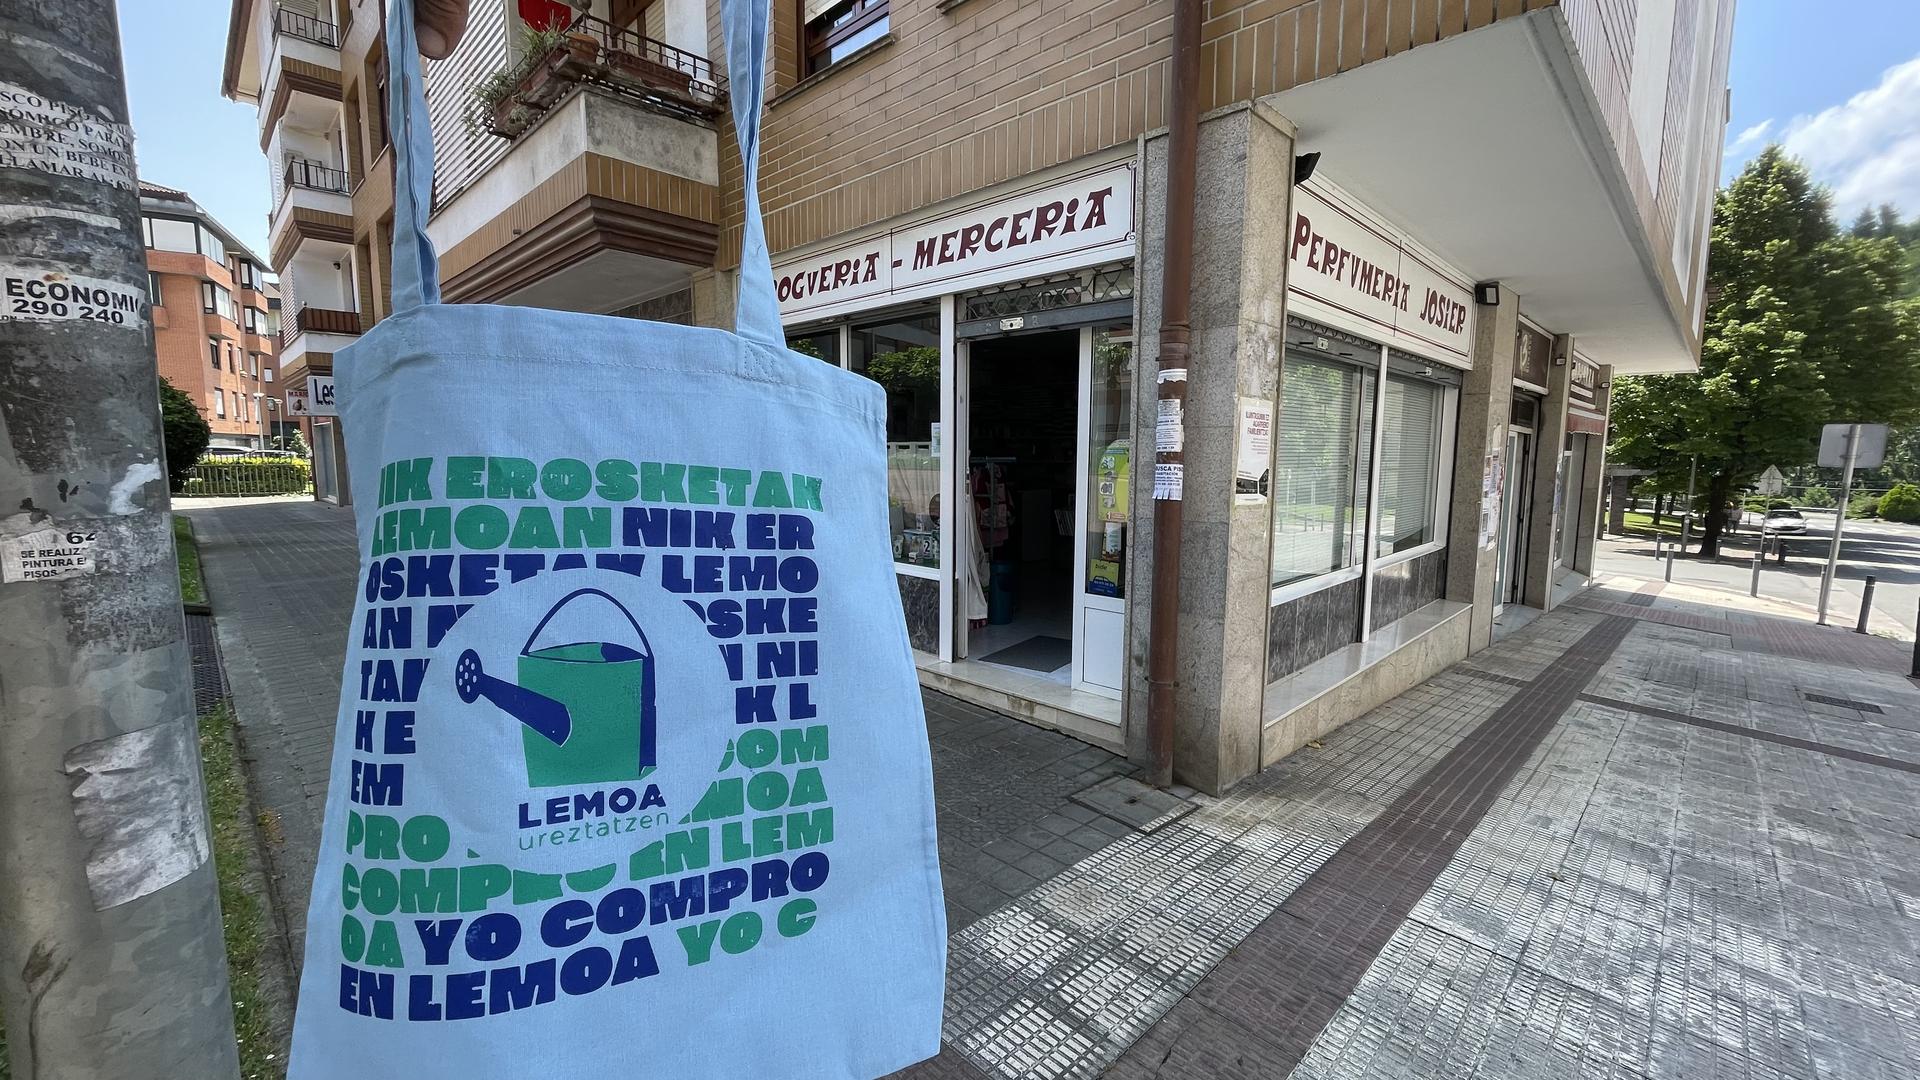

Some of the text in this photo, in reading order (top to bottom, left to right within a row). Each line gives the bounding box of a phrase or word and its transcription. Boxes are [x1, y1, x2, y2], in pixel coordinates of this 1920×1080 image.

[12, 299, 124, 324] 290 240
[446, 456, 823, 512] EROSKETAK
[371, 504, 815, 557] LEMOAN NIK ER
[21, 547, 88, 559] SE REALIZ
[22, 558, 74, 568] PINTURA
[24, 569, 57, 579] PISOS
[662, 555, 819, 593] LEMO
[363, 606, 412, 649] AN
[757, 640, 818, 679] NI
[351, 759, 404, 806] EM
[518, 784, 666, 829] LEMOA
[346, 809, 450, 862] PRO
[519, 811, 669, 850] ureztatzen
[722, 807, 833, 863] LEM
[414, 913, 522, 965] YO
[540, 851, 830, 948] COMPRO
[340, 898, 818, 1021] EN LEMOA YO C
